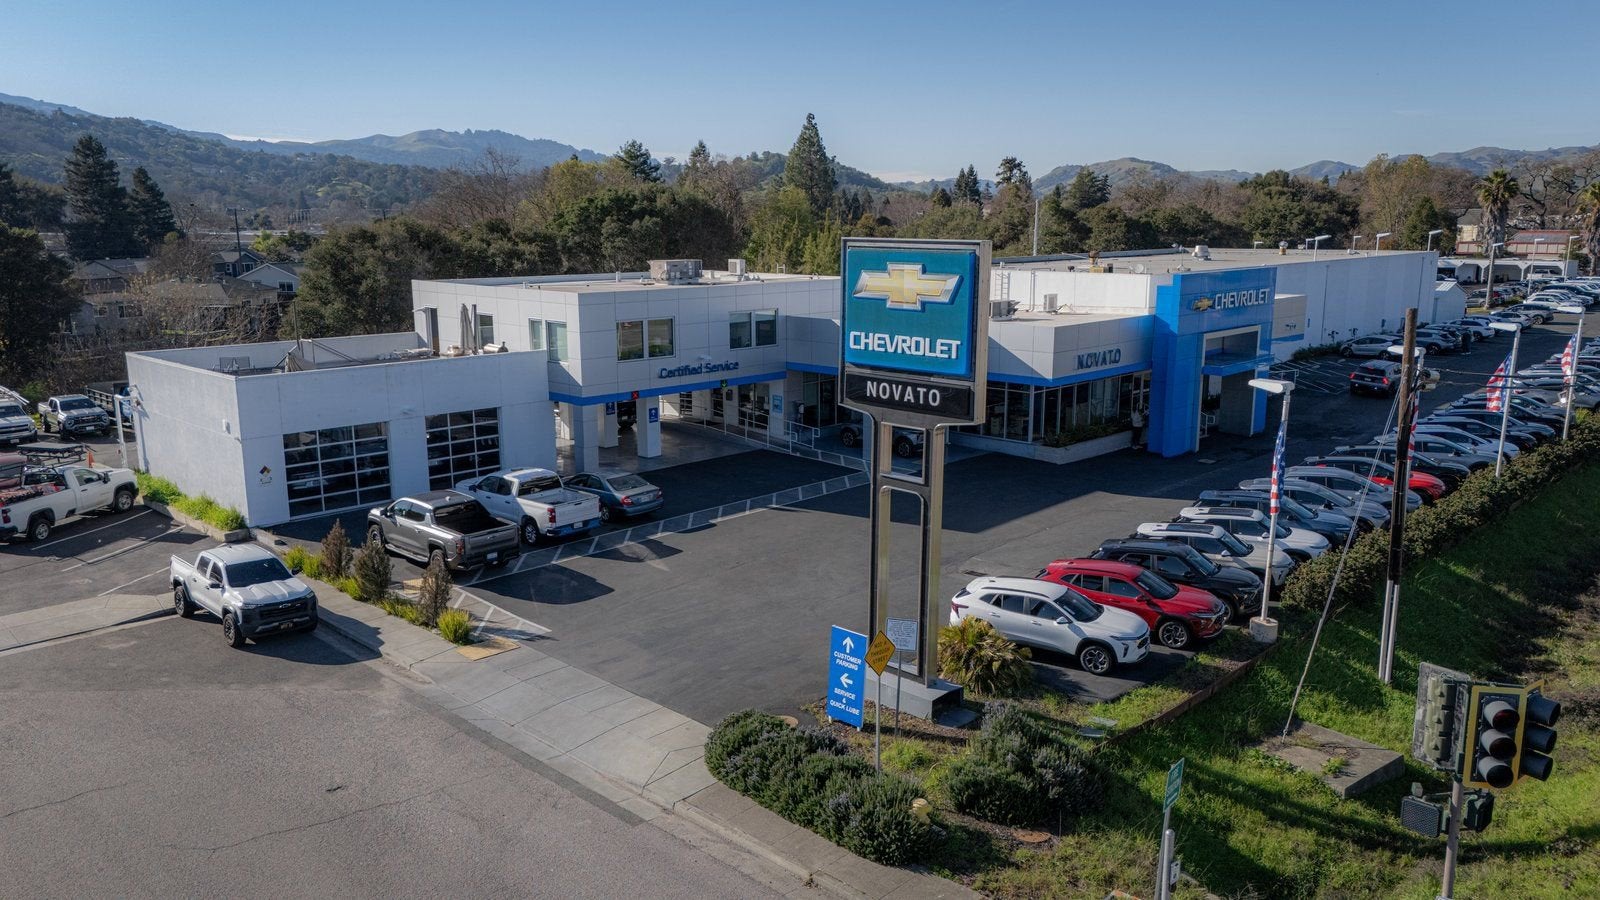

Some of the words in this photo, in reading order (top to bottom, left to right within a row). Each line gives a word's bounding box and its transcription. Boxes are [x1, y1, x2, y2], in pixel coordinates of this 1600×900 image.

[1215, 288, 1270, 310] CHEVROLET
[850, 331, 961, 359] CHEVROLET
[1077, 348, 1122, 370] NOVATO
[659, 364, 703, 379] Certified
[704, 360, 740, 373] Service
[866, 381, 941, 407] NOVATO
[834, 651, 862, 664] CUSTOMER
[836, 658, 859, 671] PARKING
[834, 688, 856, 700] SERVICE
[829, 700, 846, 711] QUICK
[846, 706, 860, 716] LUBE
